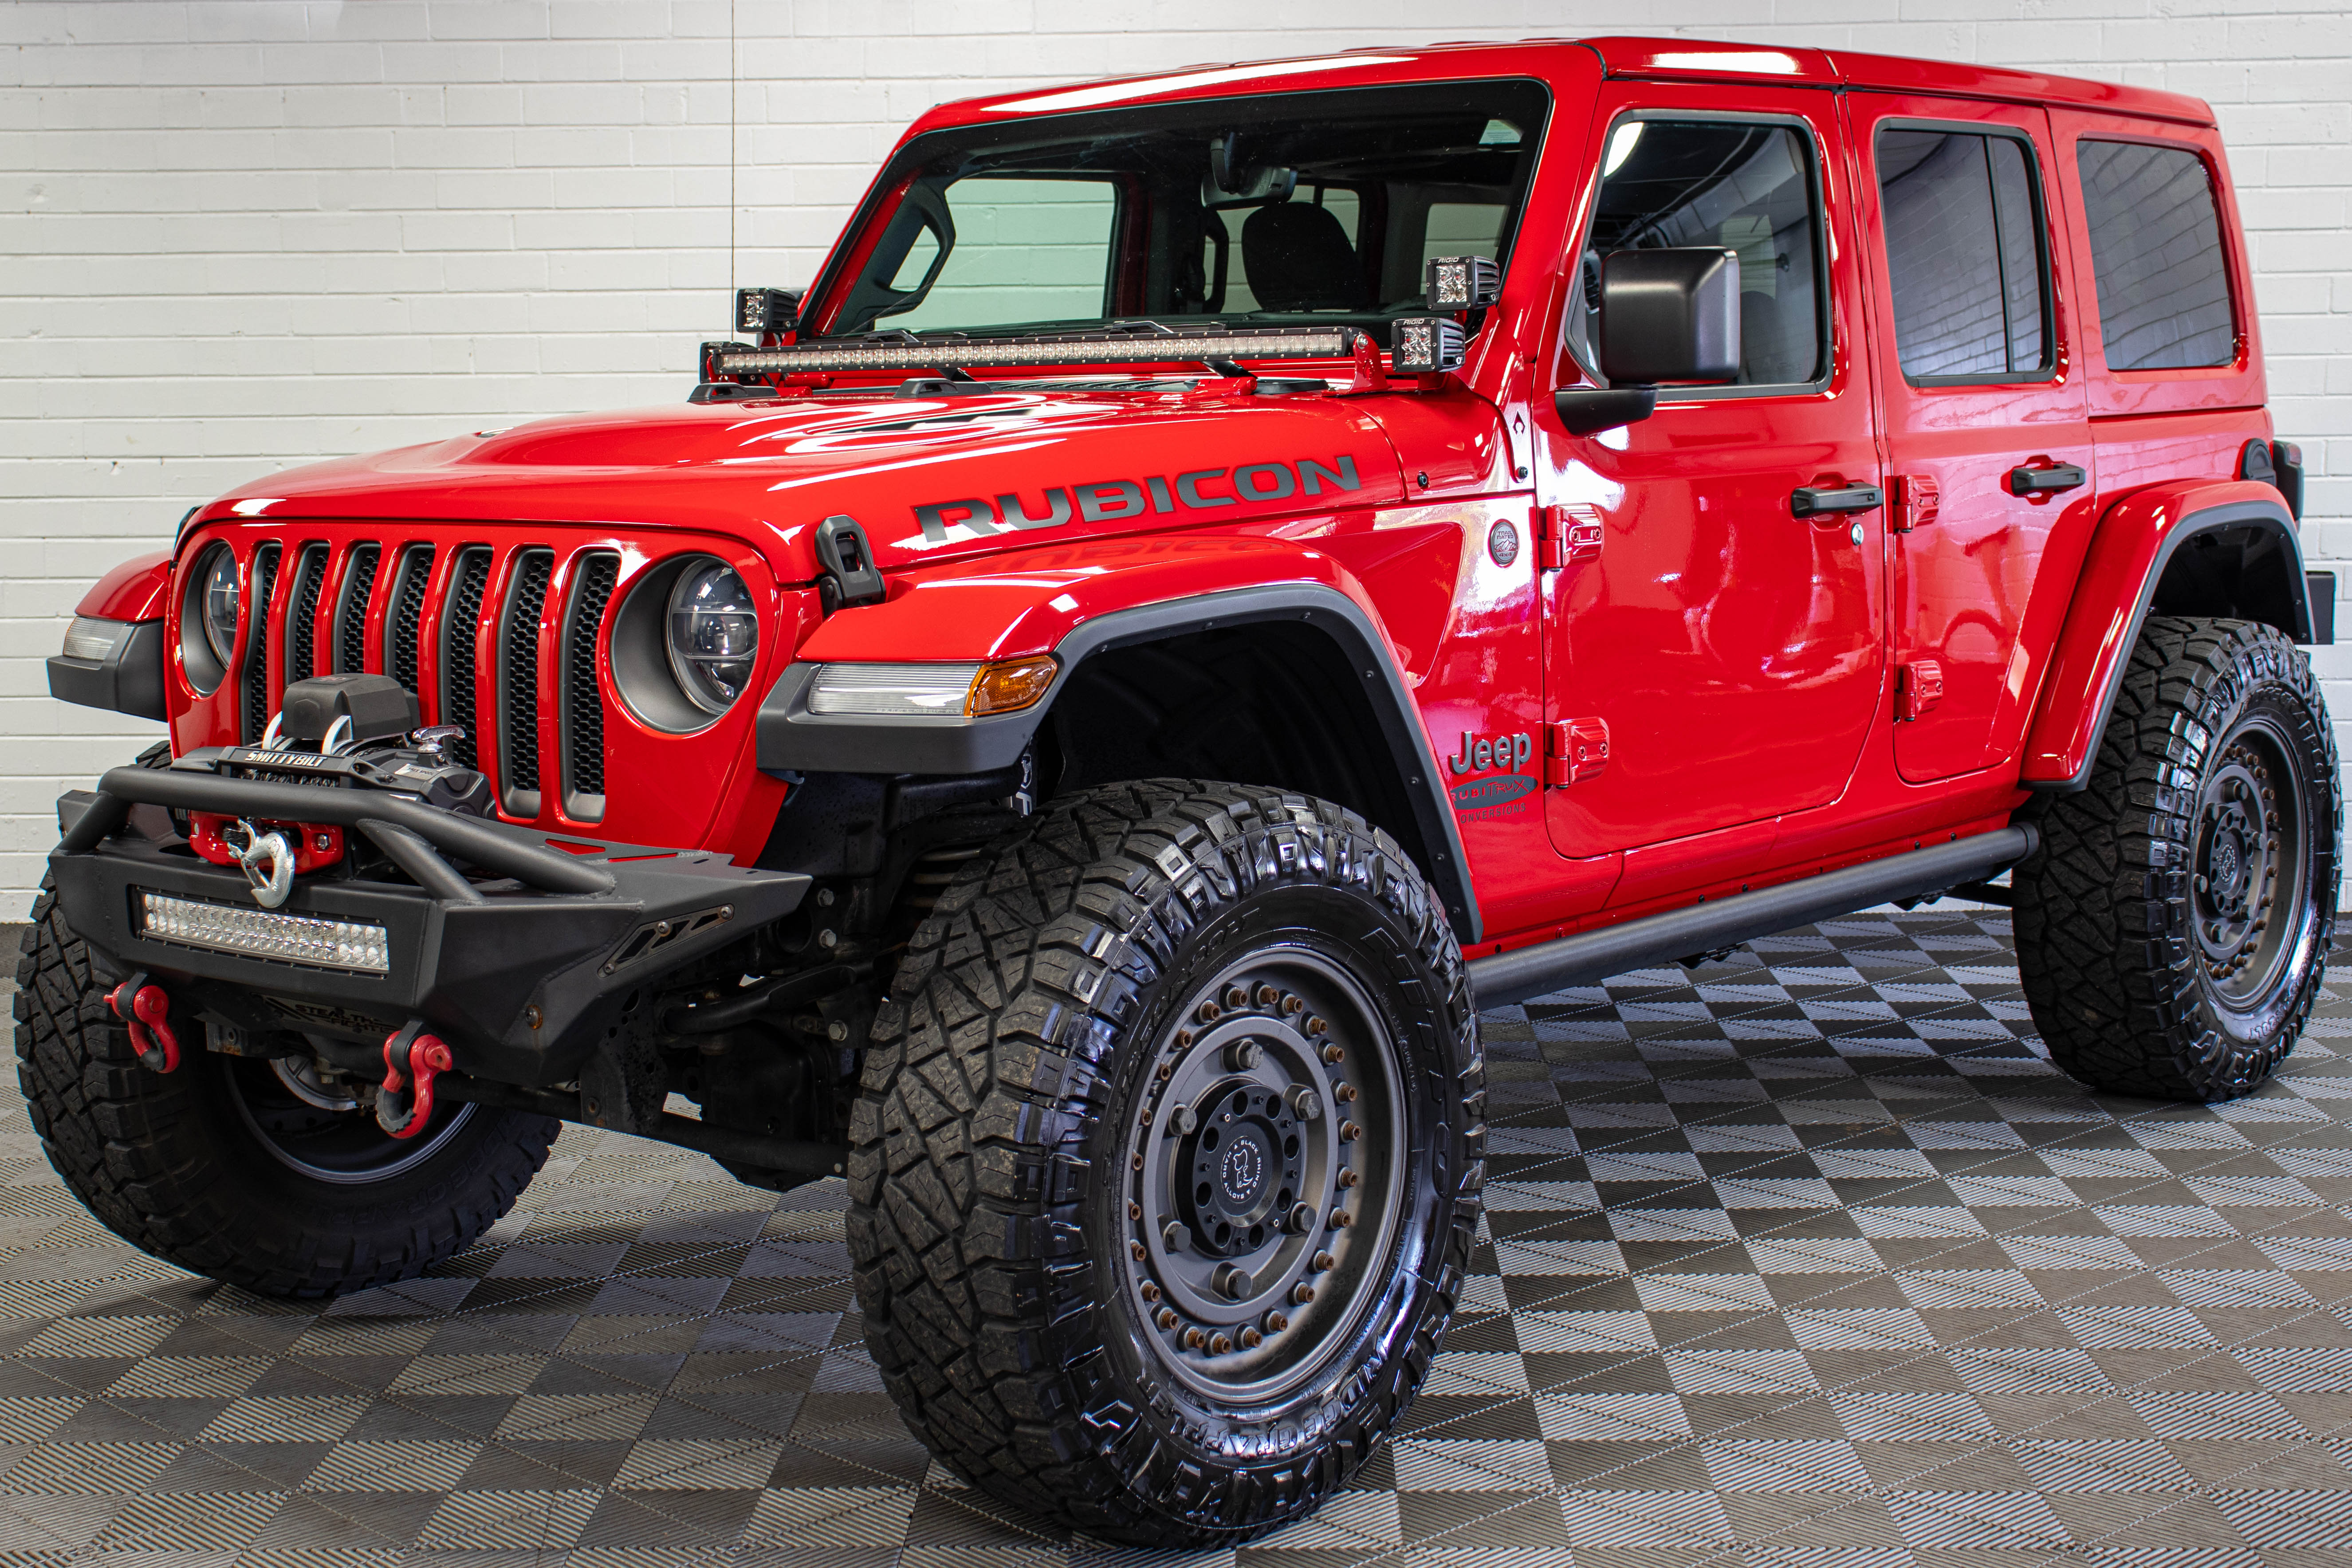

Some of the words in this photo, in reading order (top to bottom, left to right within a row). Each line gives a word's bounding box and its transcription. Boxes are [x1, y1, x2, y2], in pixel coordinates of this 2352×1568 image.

[915, 456, 1361, 543] RUBICON
[244, 751, 328, 767] SMITTYBILT
[1449, 731, 1531, 774] Jeep
[1460, 802, 1526, 824] ONVERSIONS
[1223, 1151, 1231, 1178] HARD
[1241, 1140, 1258, 1154] BLACK
[1253, 1157, 1261, 1188] RHINO
[1224, 1183, 1244, 1199] ALLOYS
[1302, 1334, 1388, 1442] RIDGE
[1137, 1368, 1298, 1456] GRAPPLER
